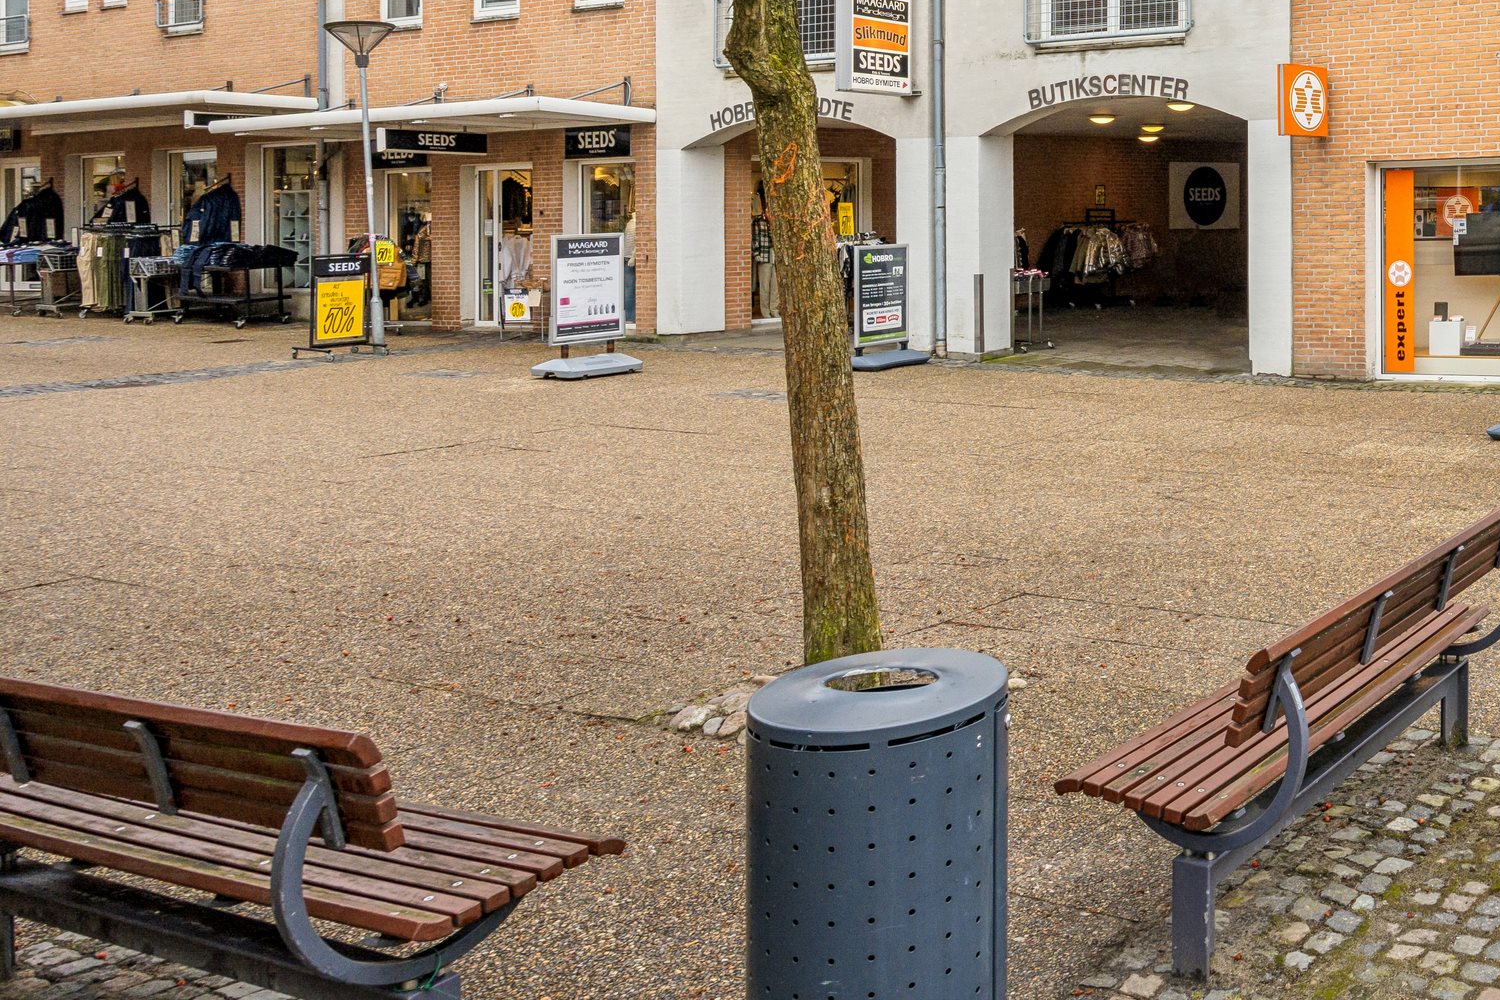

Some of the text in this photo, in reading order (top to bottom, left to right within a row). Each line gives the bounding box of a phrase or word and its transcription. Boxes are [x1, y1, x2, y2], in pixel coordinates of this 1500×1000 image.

[856, 6, 905, 20] hårdesign
[855, 26, 906, 46] Slikmund
[859, 51, 901, 73] SEEDS
[853, 76, 900, 88] HOBRO BYMIDTE
[1028, 74, 1189, 110] BUTIKSCENTER
[709, 102, 756, 131] HOBR
[418, 133, 456, 146] SEEDS
[578, 130, 616, 150] SEEDS
[1188, 188, 1221, 202] SEEDS
[568, 240, 608, 250] MAAGAARD
[328, 262, 360, 272] SEEDS
[872, 254, 894, 263] HOBRO
[324, 304, 356, 334] 50%
[1396, 291, 1407, 361] expert
